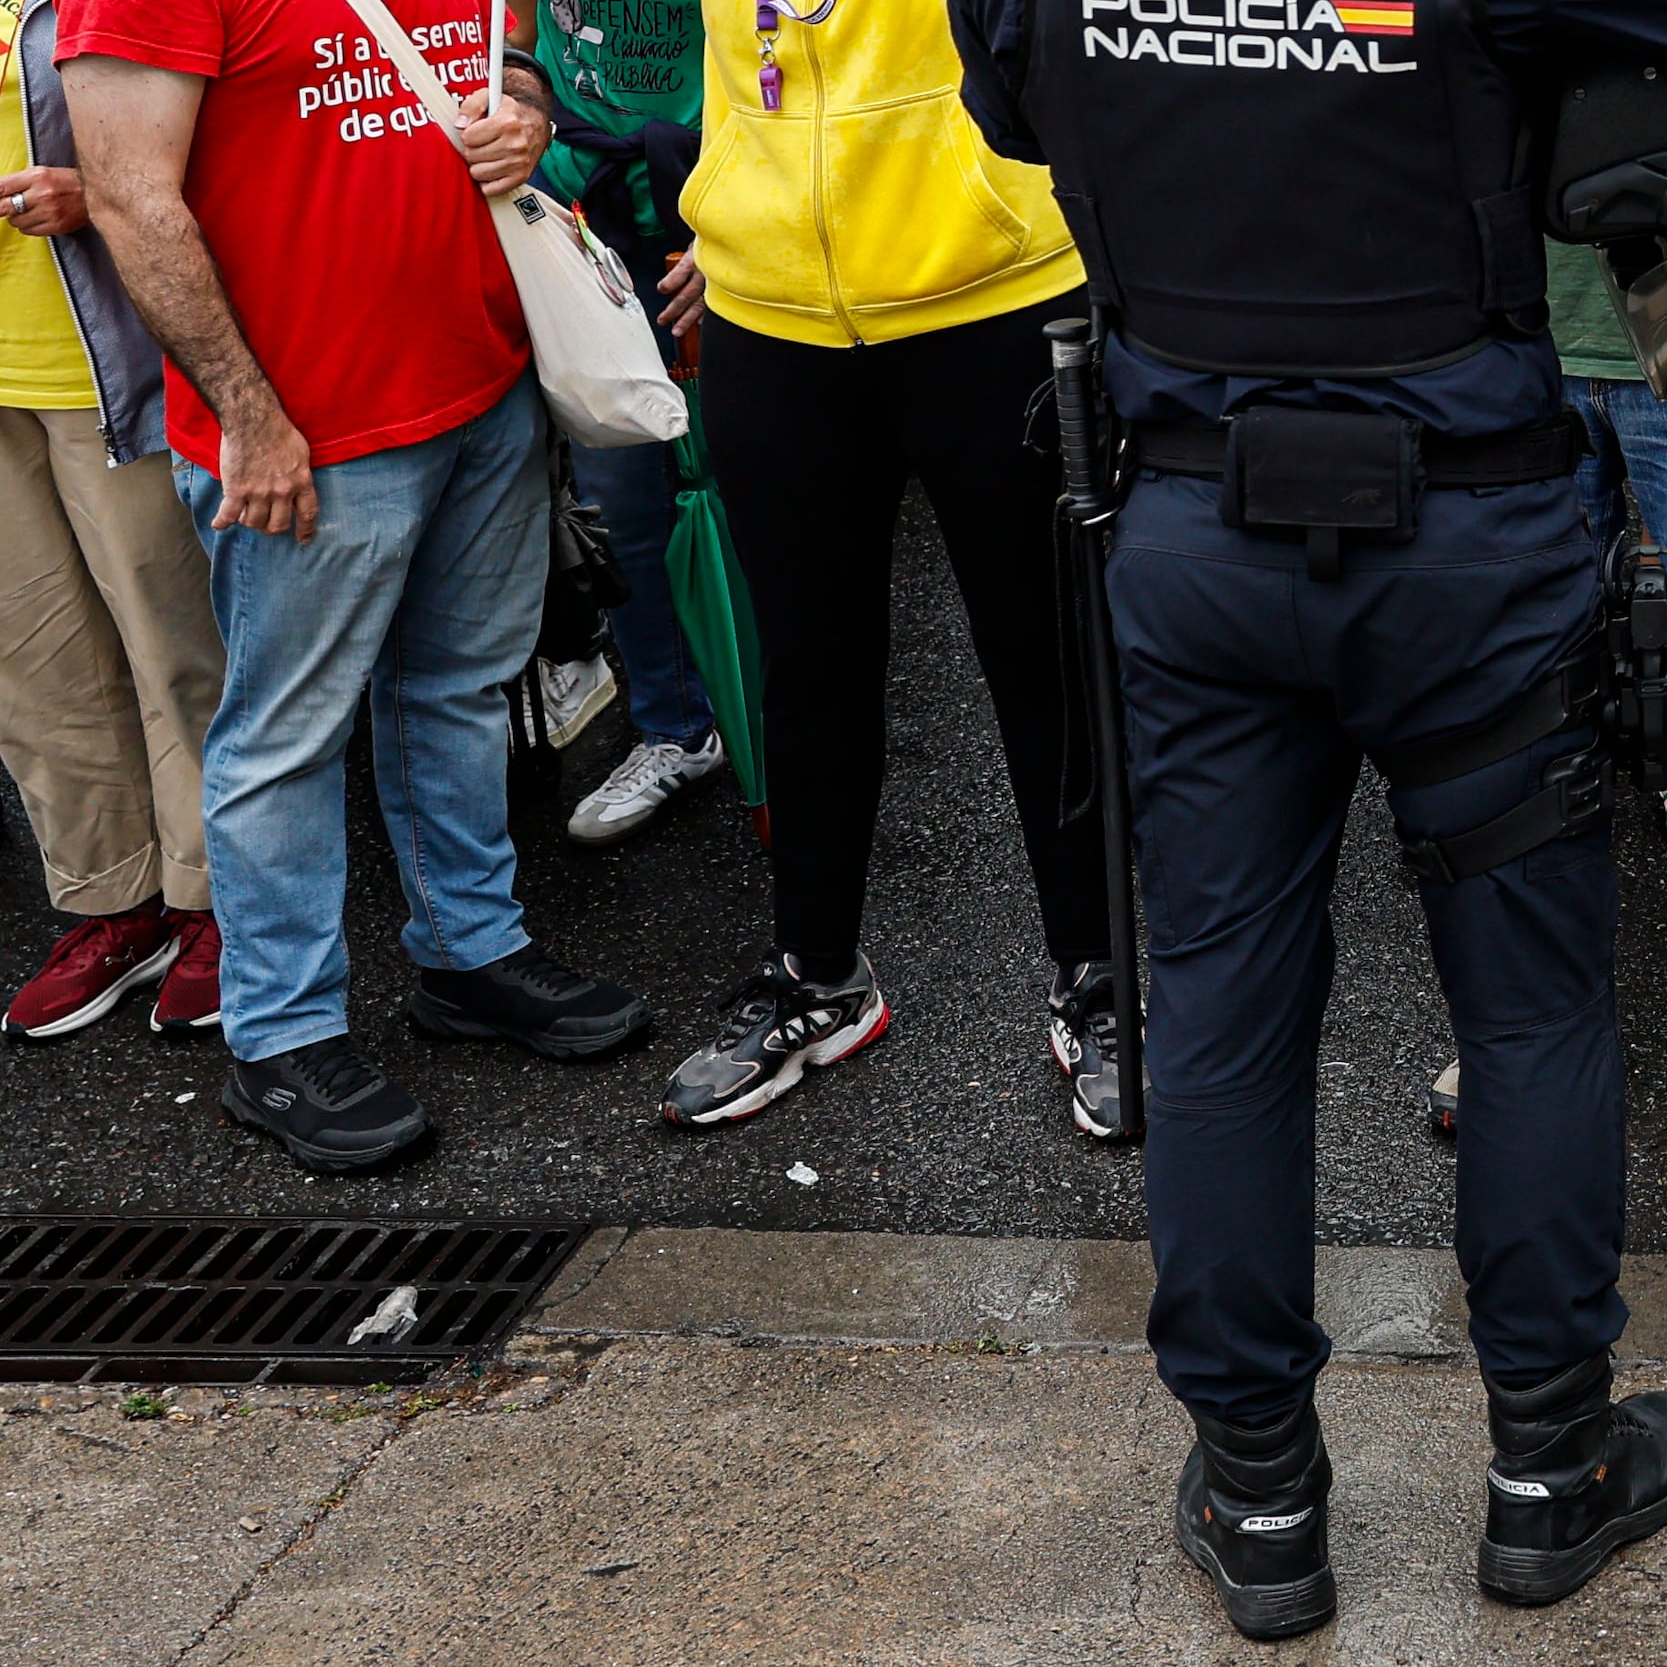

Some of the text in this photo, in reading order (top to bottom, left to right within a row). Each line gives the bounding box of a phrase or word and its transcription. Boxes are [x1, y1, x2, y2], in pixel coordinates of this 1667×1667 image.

[313, 32, 345, 70] Sí
[354, 36, 371, 62] a
[411, 13, 484, 53] servei
[1083, 26, 1418, 74] NACIONAL
[339, 103, 385, 143] de
